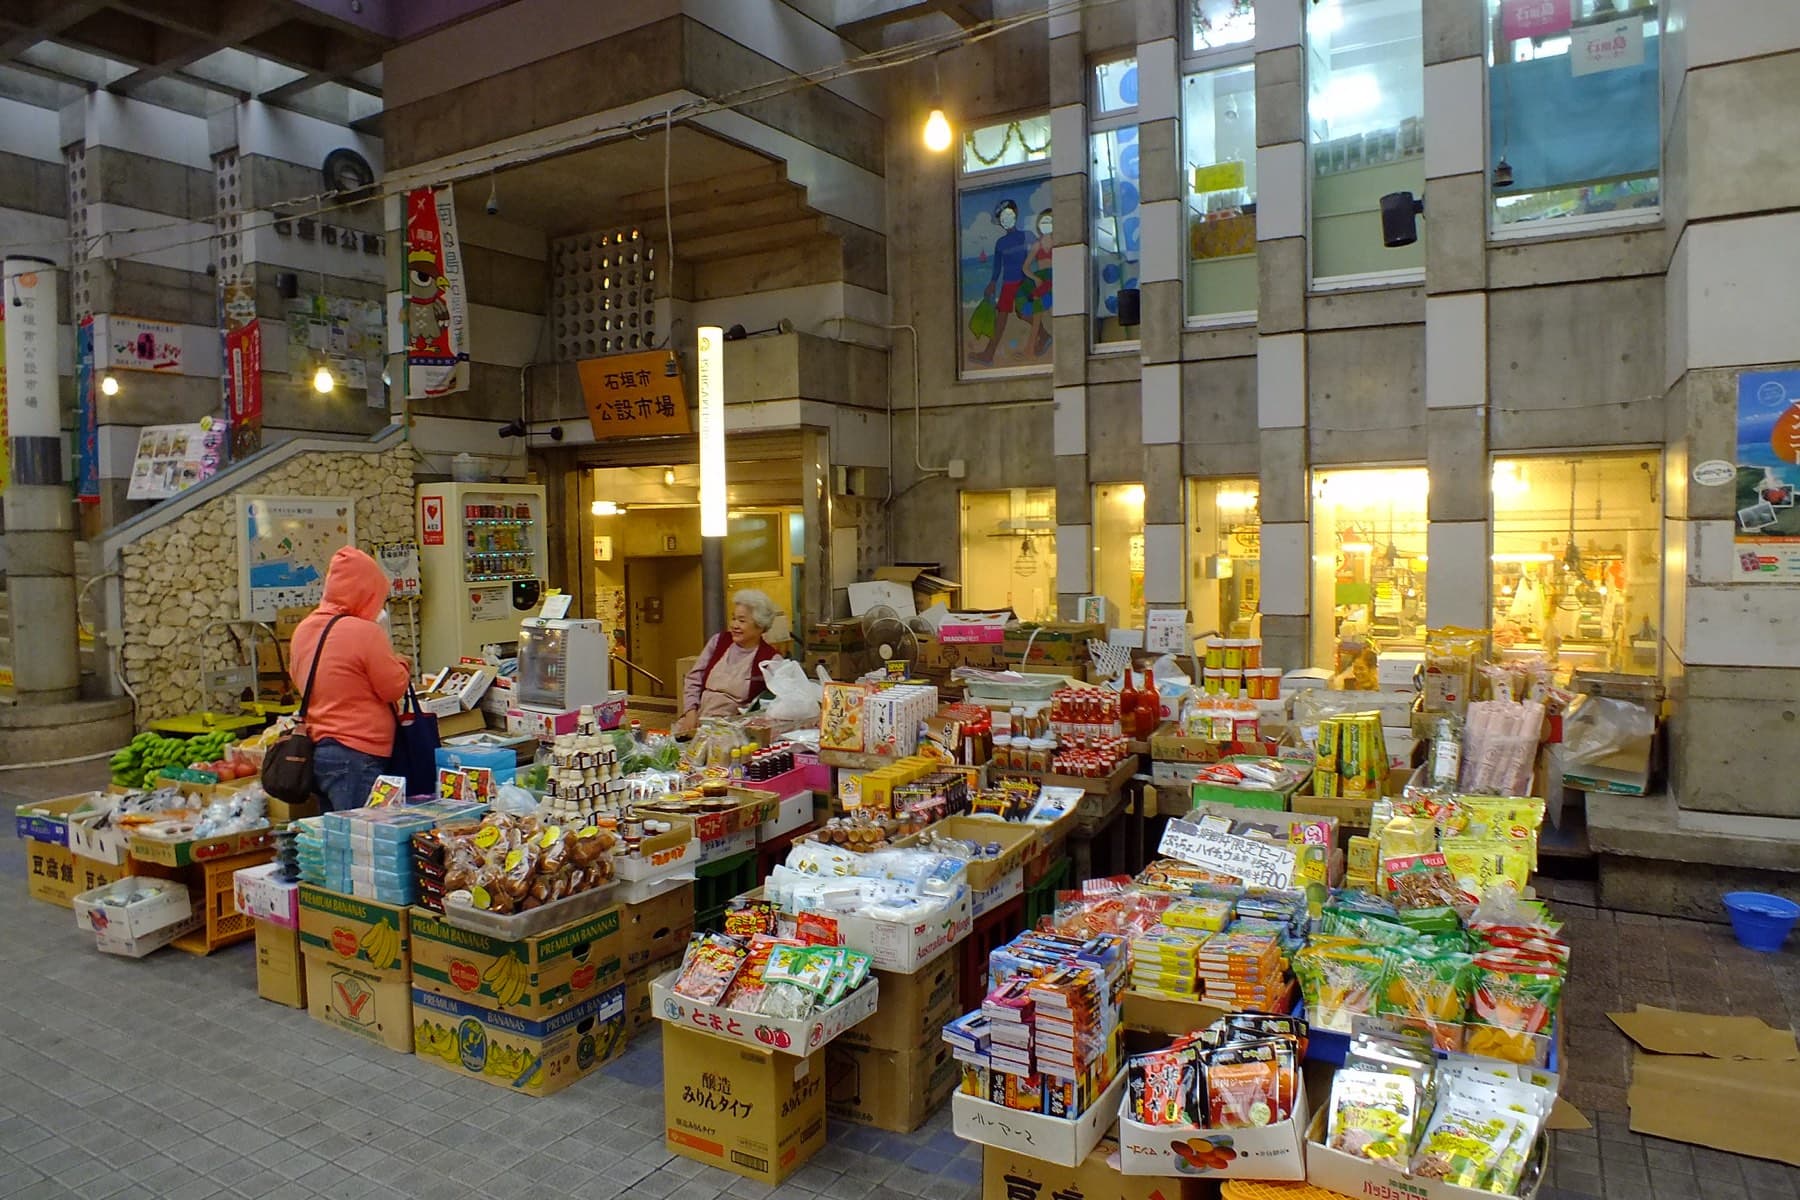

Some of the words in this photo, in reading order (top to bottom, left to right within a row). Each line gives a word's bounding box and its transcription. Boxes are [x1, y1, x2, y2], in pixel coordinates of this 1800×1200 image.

[604, 369, 652, 390] 石垣市
[595, 395, 675, 421] 公設市場
[1253, 869, 1288, 890] ¥500
[413, 920, 449, 941] PREMIUM
[450, 928, 490, 951] BANANAS
[539, 930, 579, 957] PREMIUM
[579, 916, 618, 941] BANANAS
[423, 993, 448, 1013] PREMIUM
[487, 1012, 525, 1032] BANANAS
[546, 1004, 586, 1033] PREMIUM
[691, 1007, 744, 1036] とまと
[682, 1085, 753, 1119] みりんタイプ
